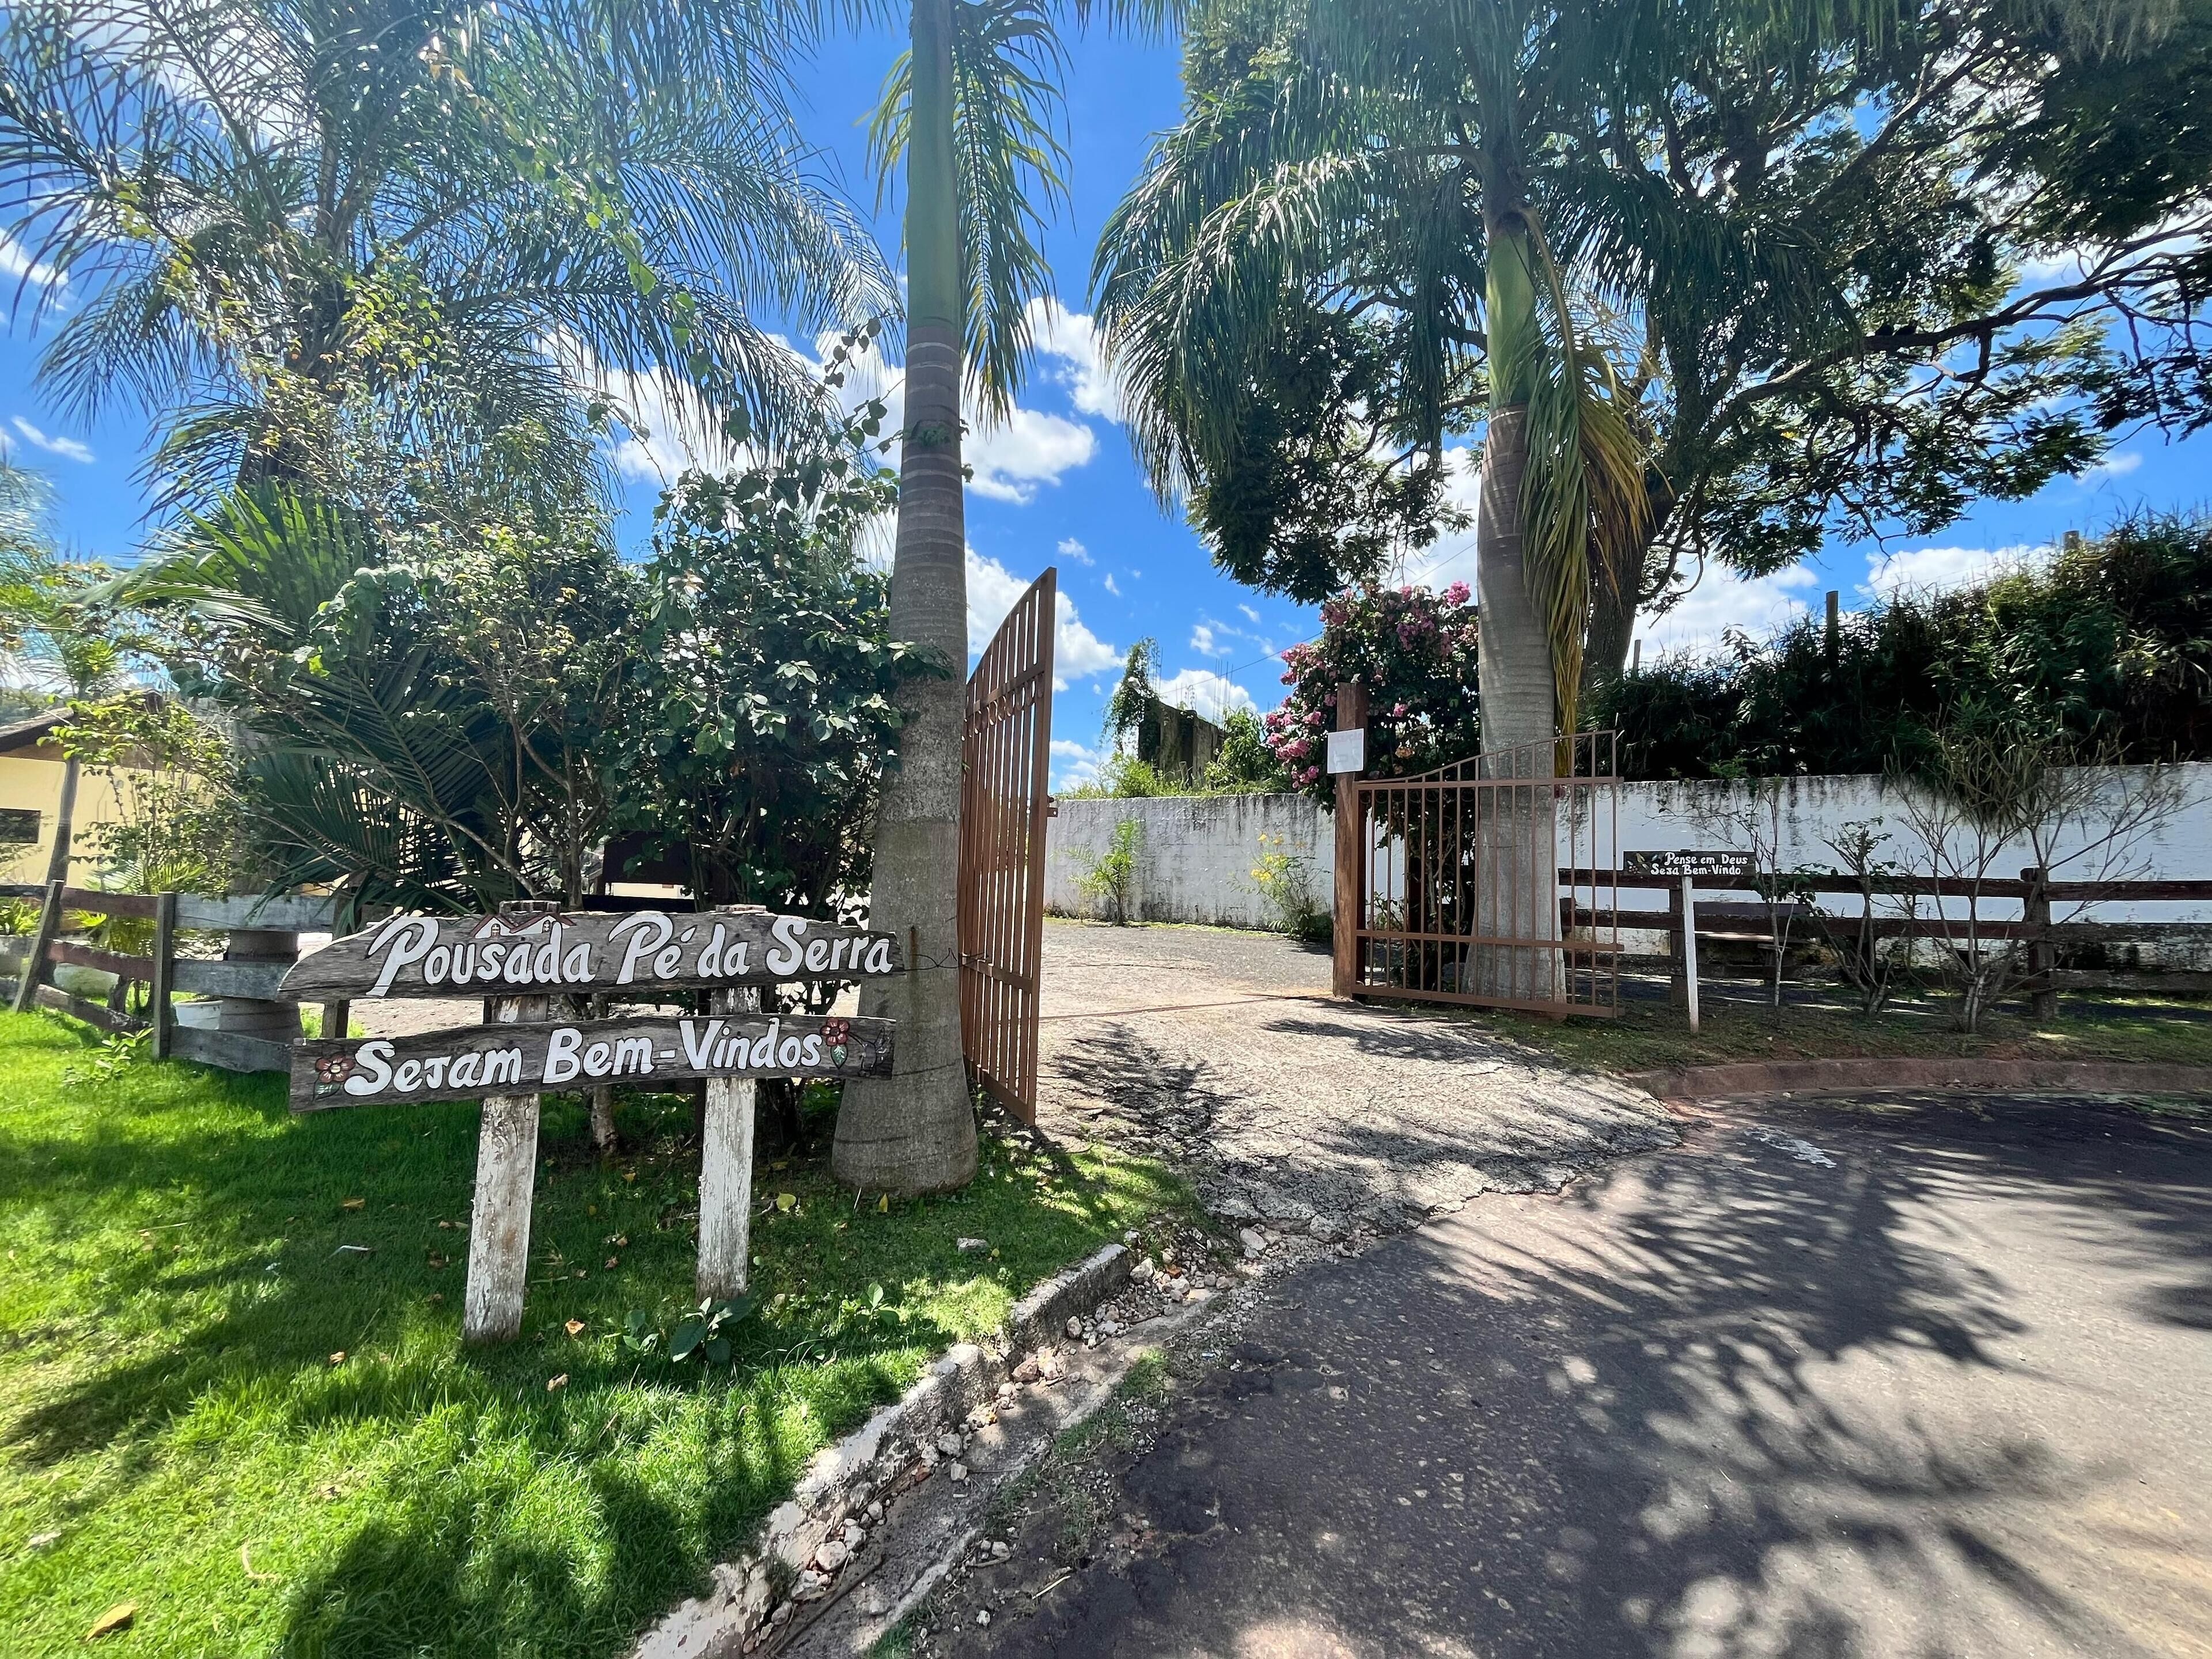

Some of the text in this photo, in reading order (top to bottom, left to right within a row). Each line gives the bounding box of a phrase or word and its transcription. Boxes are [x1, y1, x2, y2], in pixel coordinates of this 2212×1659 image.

[1664, 851, 1748, 865] Pense em Deus
[366, 913, 894, 997] Pousada Pé da Serra
[543, 1017, 823, 1084] Bem-Vindos
